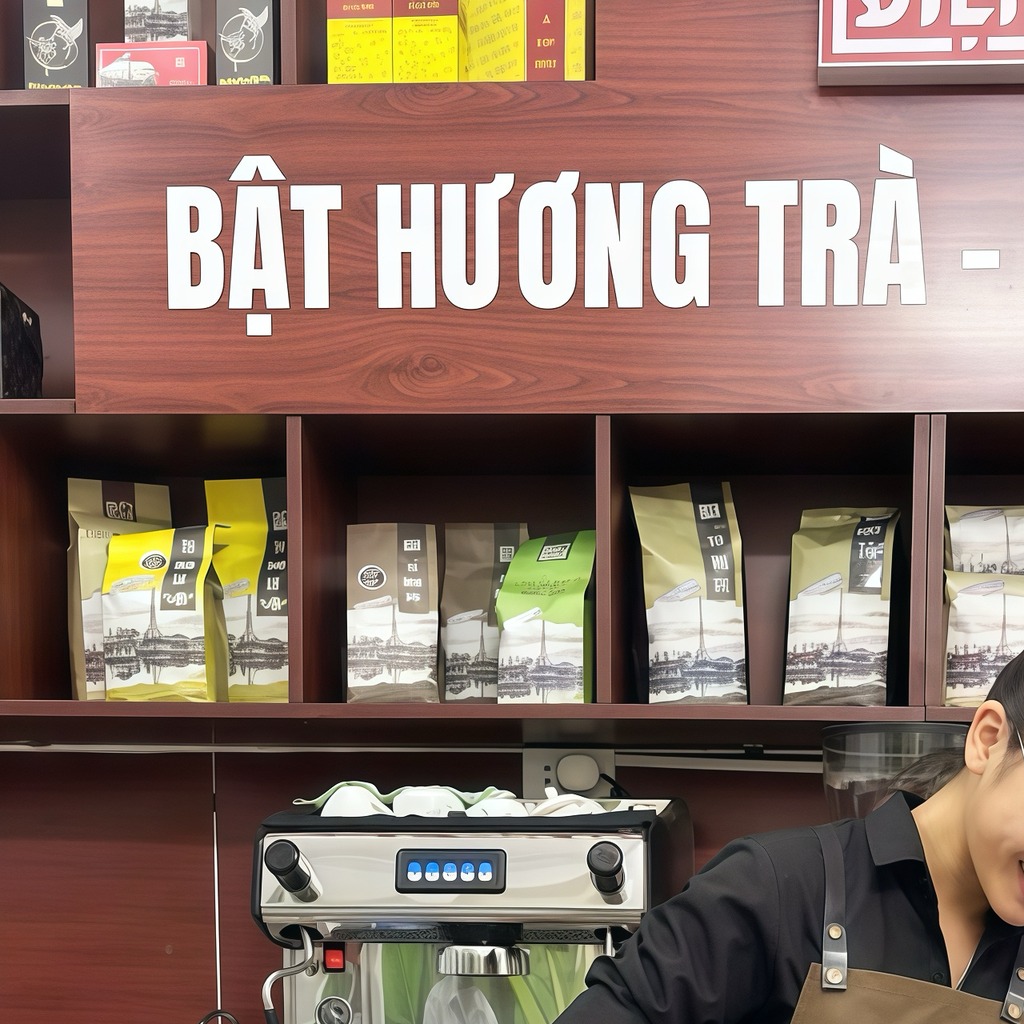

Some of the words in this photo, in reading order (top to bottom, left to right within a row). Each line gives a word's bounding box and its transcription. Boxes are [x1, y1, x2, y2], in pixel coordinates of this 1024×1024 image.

[165, 154, 343, 337] BẬT
[376, 170, 711, 310] HƯƠNG
[744, 143, 928, 307] TRÀ
[961, 249, 1001, 270] -
